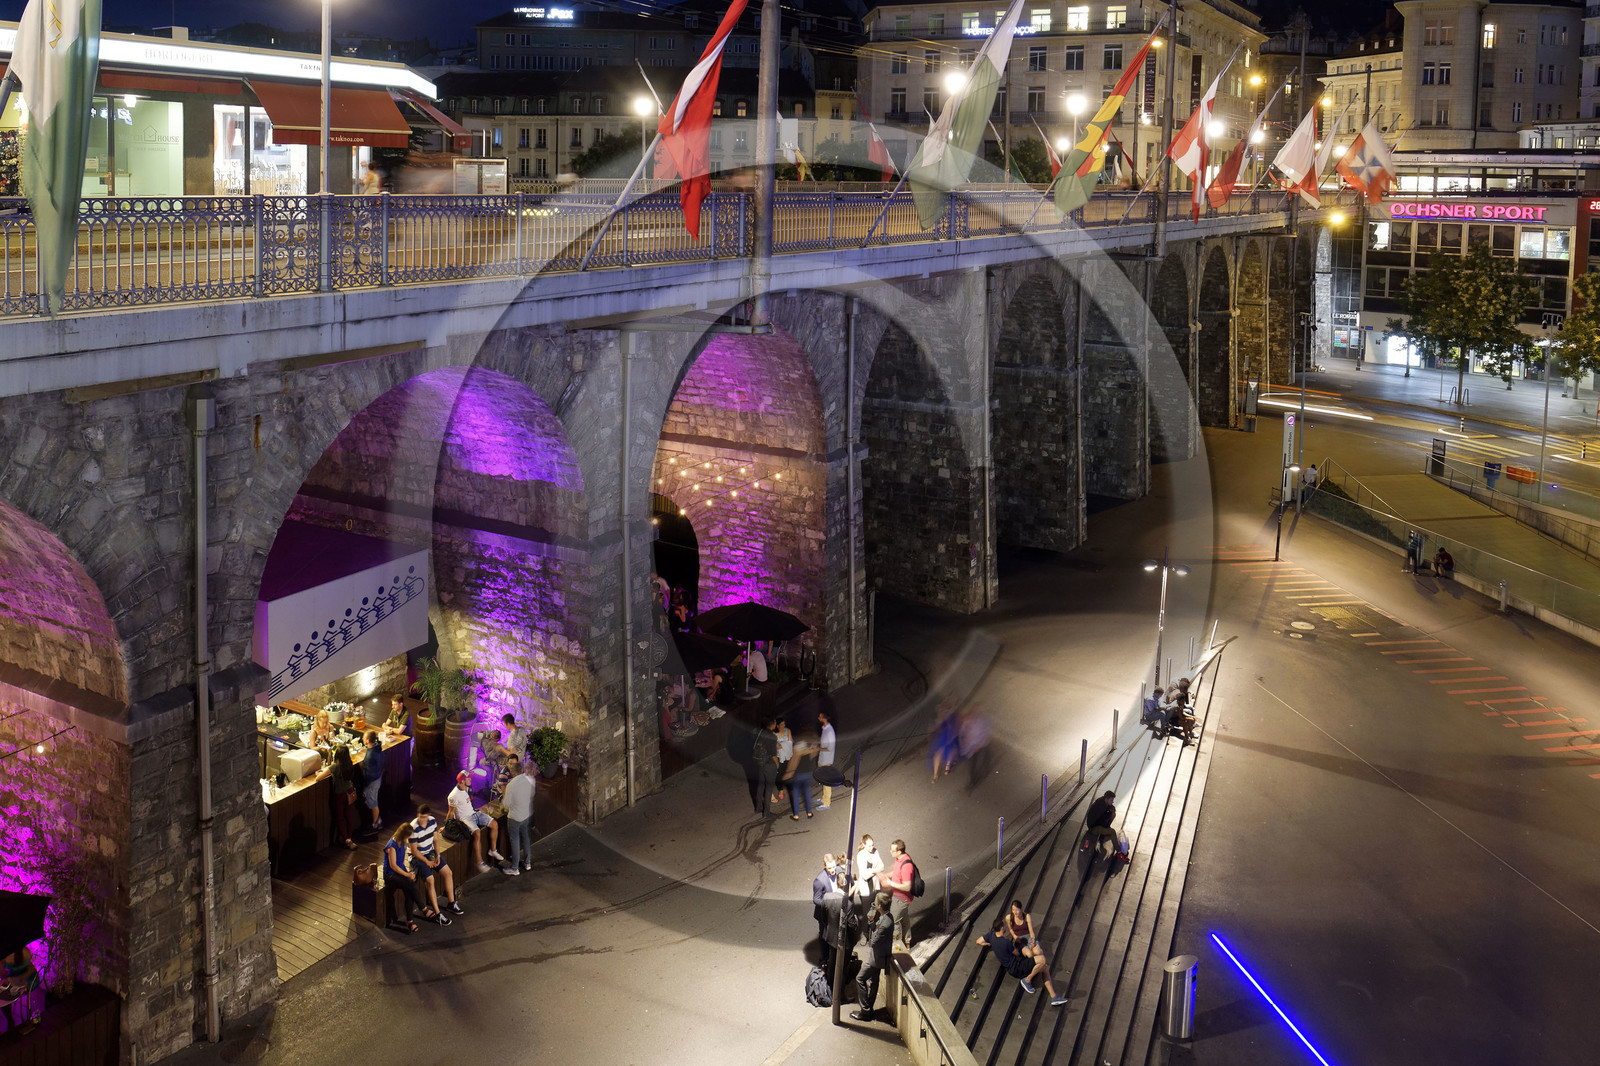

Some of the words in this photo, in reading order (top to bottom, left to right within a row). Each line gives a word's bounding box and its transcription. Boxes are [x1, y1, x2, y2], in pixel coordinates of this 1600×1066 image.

[1013, 25, 1037, 36] NÇOIS
[300, 63, 321, 71] TAKIN
[1390, 202, 1476, 218] OCHSNER
[1482, 205, 1547, 220] SPORT
